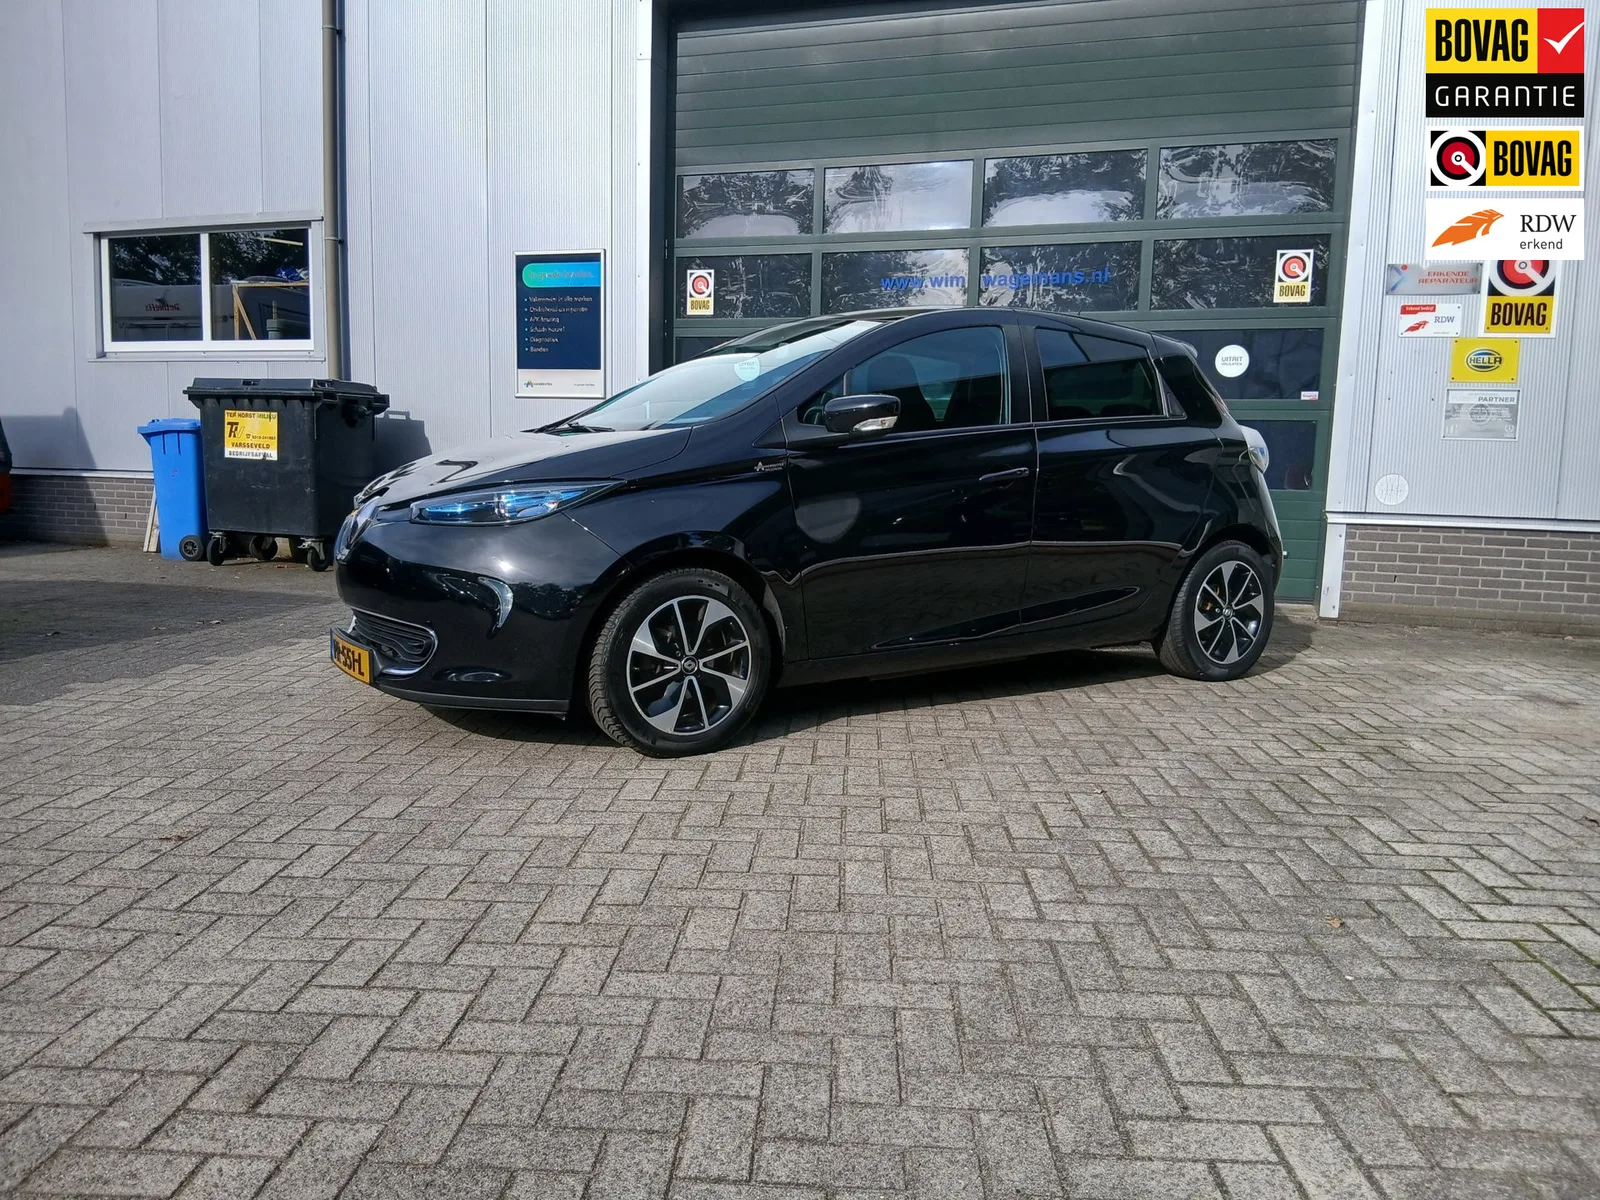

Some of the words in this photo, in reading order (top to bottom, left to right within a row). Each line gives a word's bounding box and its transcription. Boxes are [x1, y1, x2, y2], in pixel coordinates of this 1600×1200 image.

[880, 273, 966, 290] www.wim
[982, 266, 1110, 290] wagemans.nl
[1278, 284, 1306, 297] BOVAG
[690, 299, 710, 311] BOVAG
[1490, 302, 1547, 327] BOVAG
[1469, 356, 1502, 365] HELLA
